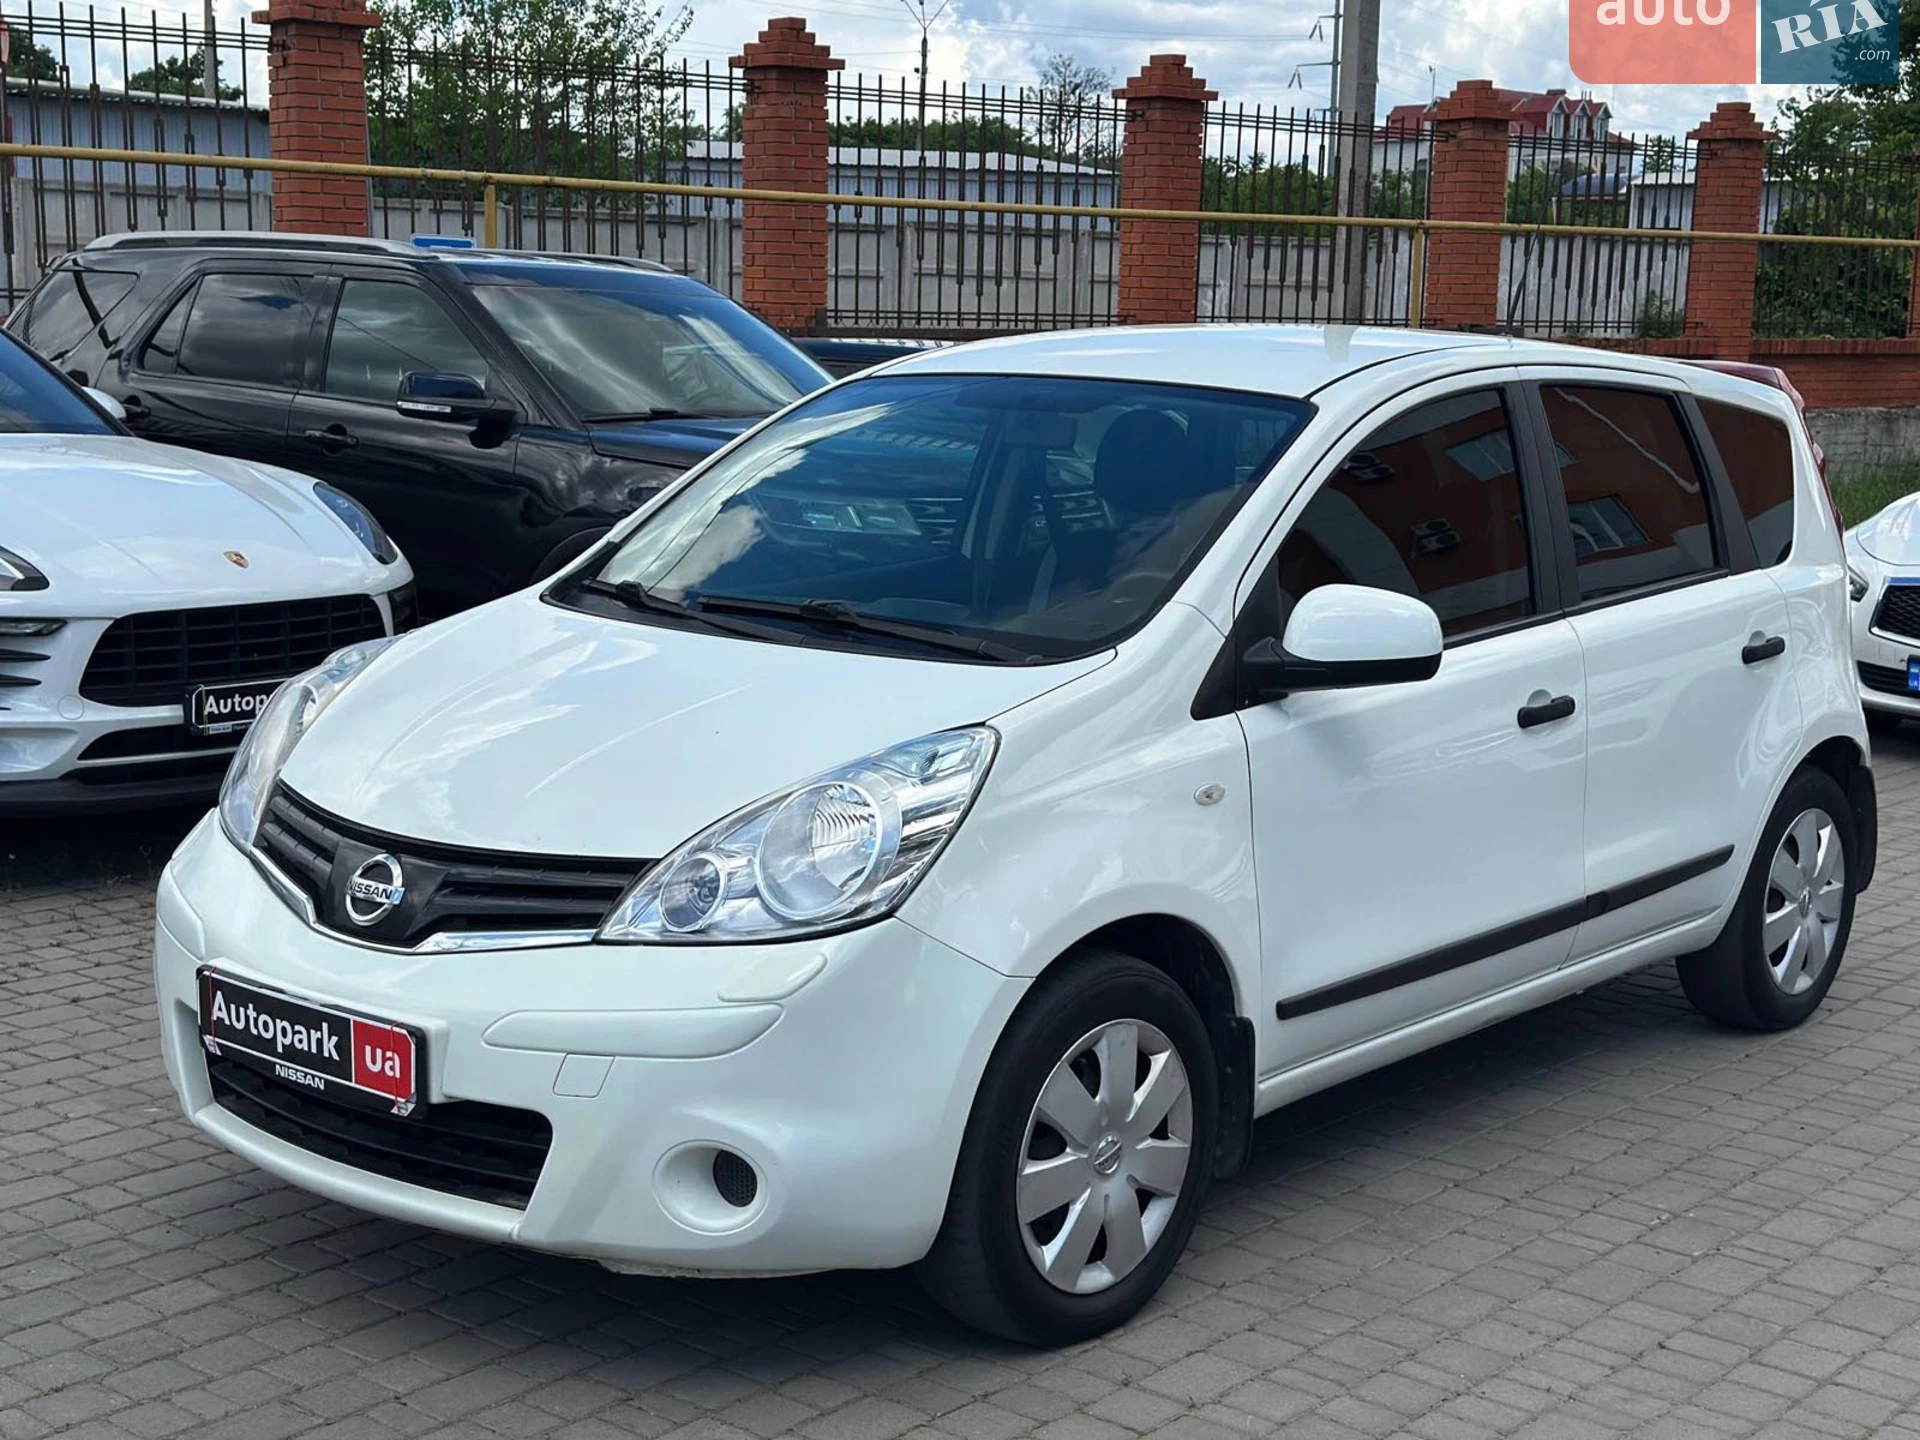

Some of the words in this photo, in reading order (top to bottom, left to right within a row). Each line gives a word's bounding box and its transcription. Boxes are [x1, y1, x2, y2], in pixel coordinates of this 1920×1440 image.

[204, 694, 270, 715] Autop
[213, 990, 341, 1061] Autopark
[365, 1044, 401, 1079] ua
[275, 1064, 325, 1091] NISSAN
